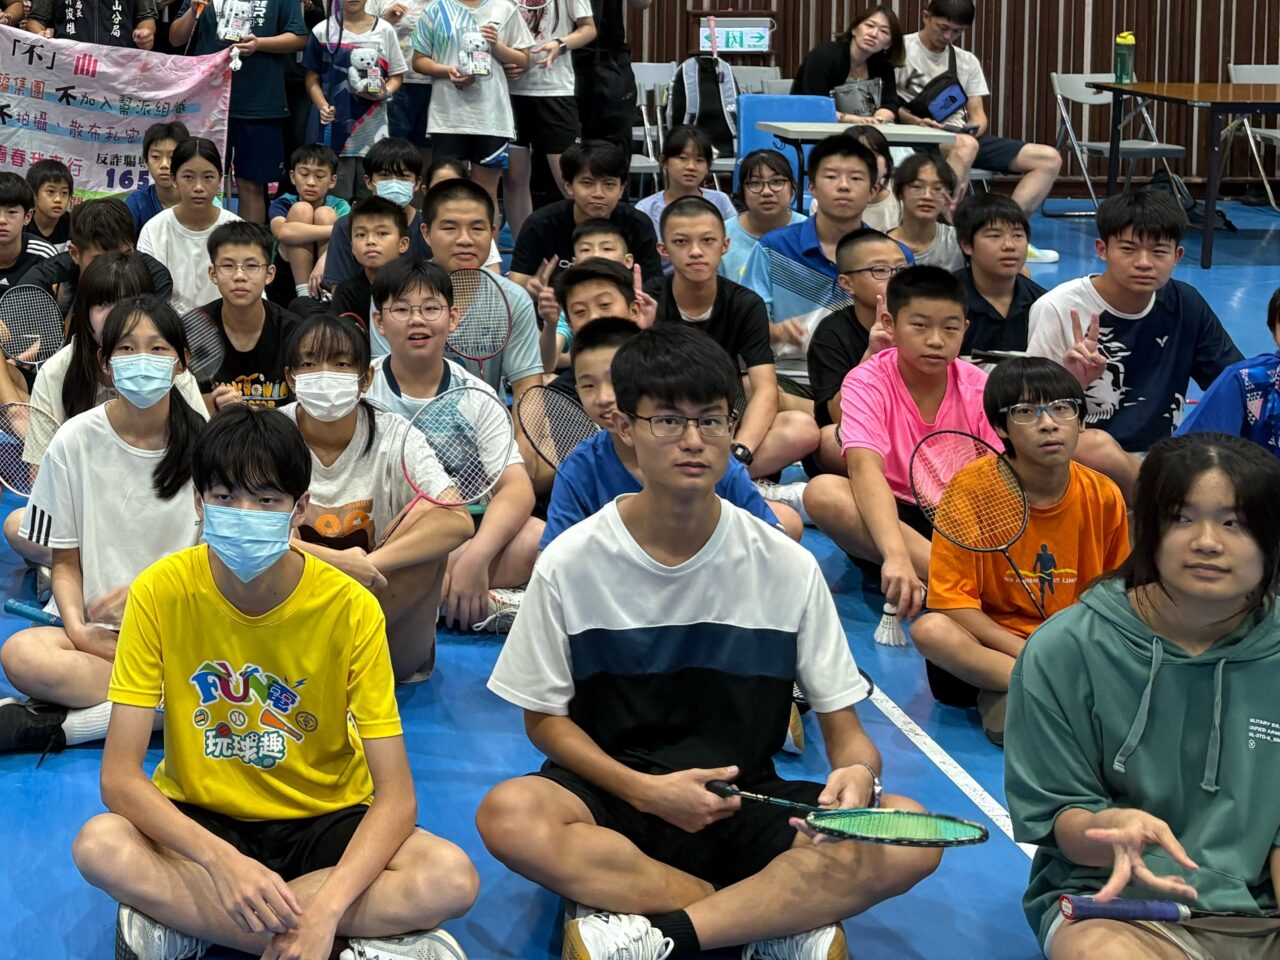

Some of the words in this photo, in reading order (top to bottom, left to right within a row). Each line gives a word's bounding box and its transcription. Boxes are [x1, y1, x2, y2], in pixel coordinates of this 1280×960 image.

[106, 168, 149, 190] 165
[206, 729, 284, 761] 玩球趣
